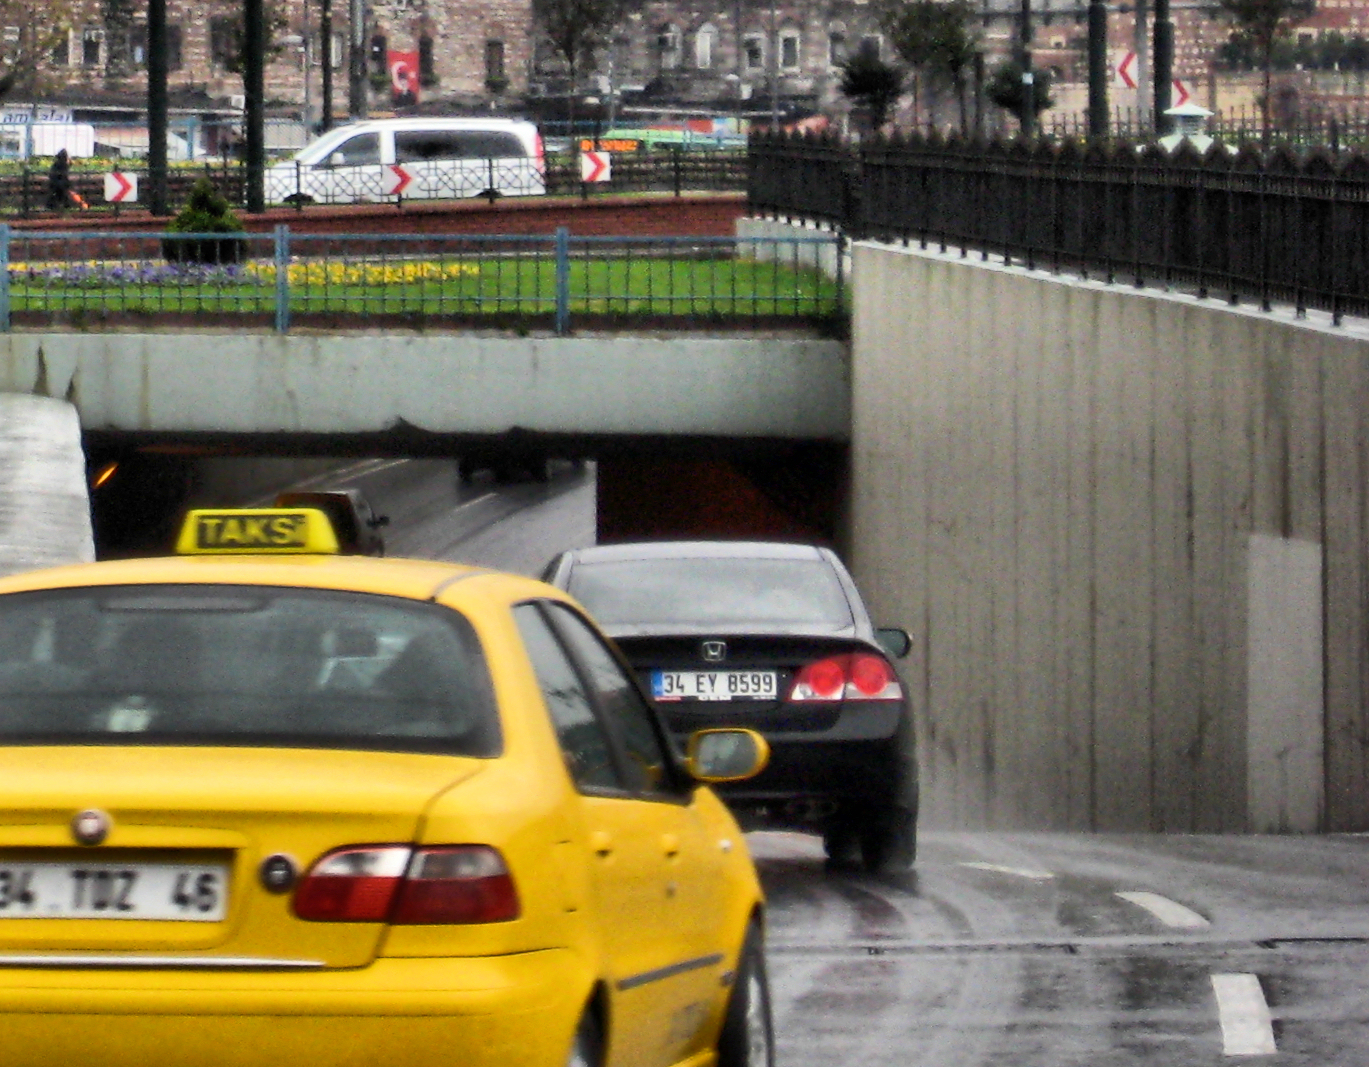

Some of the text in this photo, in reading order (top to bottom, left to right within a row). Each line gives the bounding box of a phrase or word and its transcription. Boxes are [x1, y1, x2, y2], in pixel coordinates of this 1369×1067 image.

[663, 673, 774, 694] 34 EY 8599
